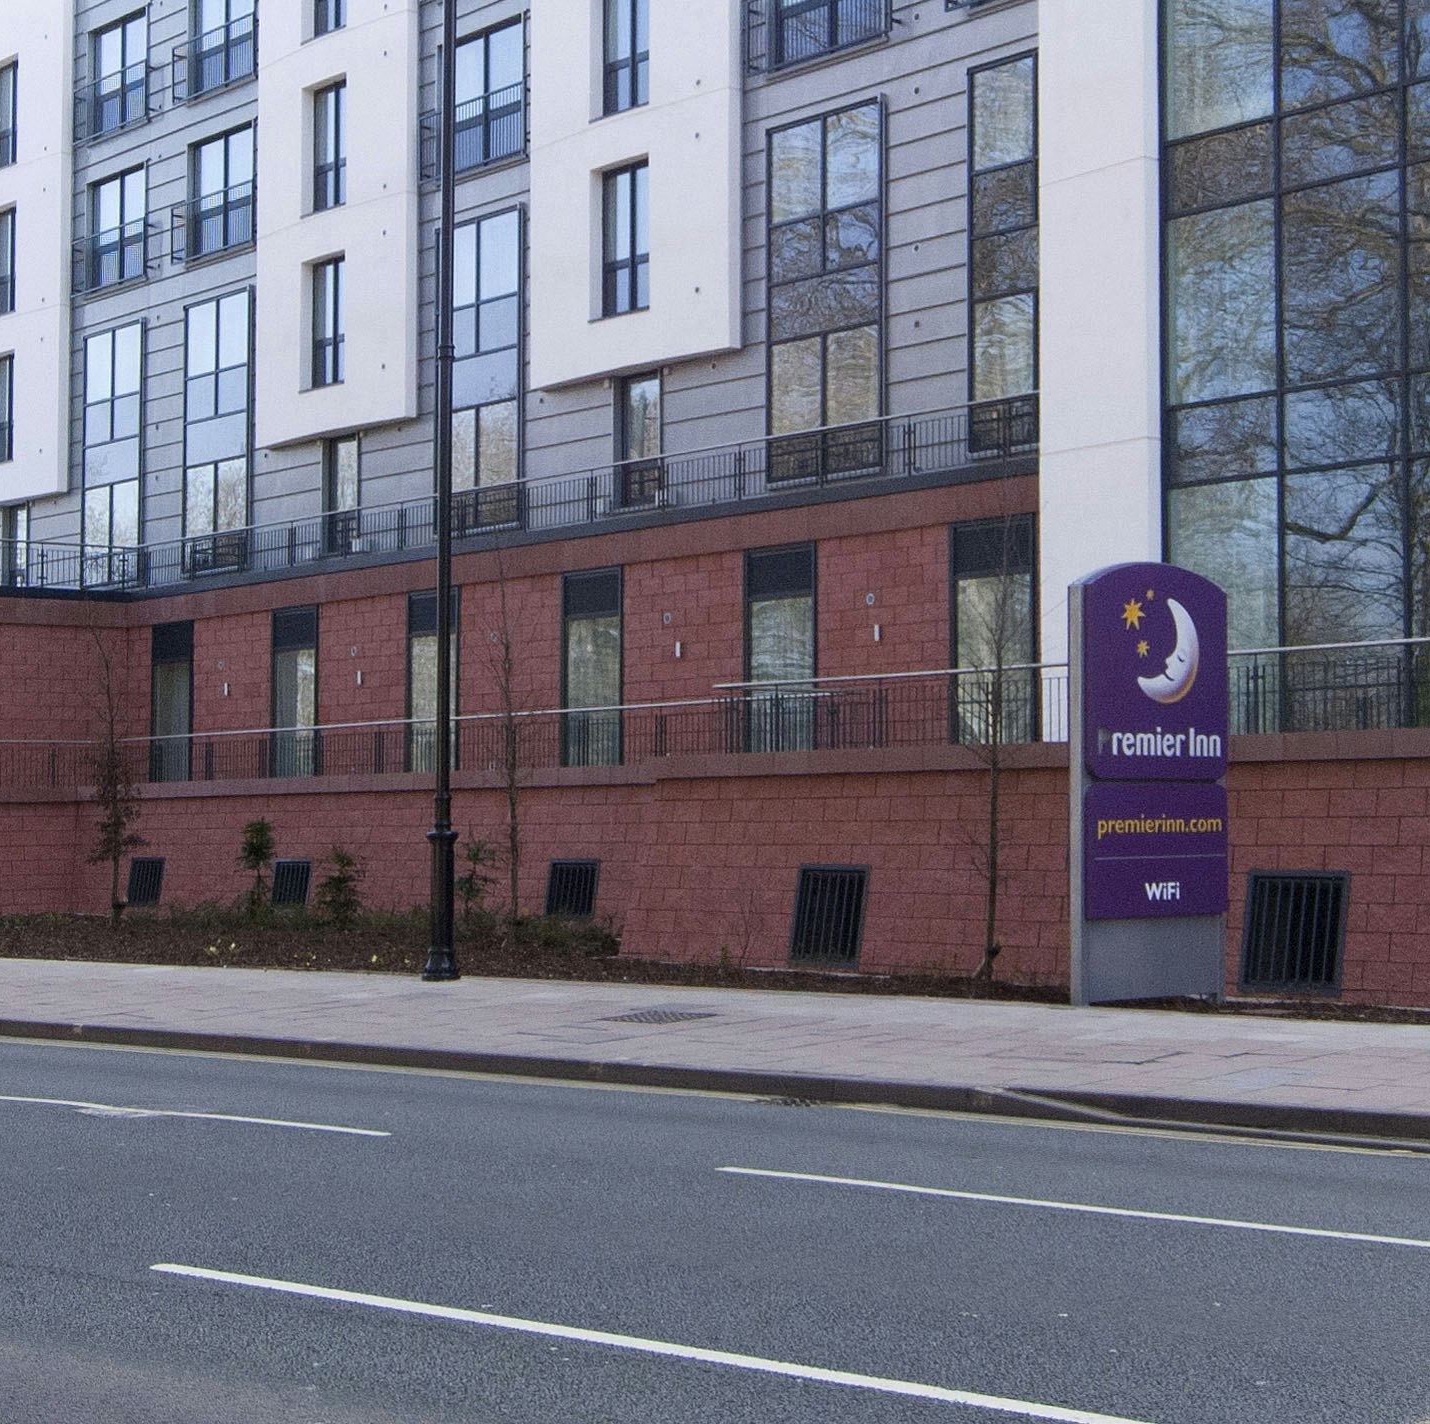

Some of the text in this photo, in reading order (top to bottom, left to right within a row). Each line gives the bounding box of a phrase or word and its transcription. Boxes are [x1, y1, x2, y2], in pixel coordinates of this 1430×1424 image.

[1189, 728, 1222, 757] Inn
[1098, 814, 1222, 840] premierinn.com
[1145, 882, 1180, 901] WiFi
